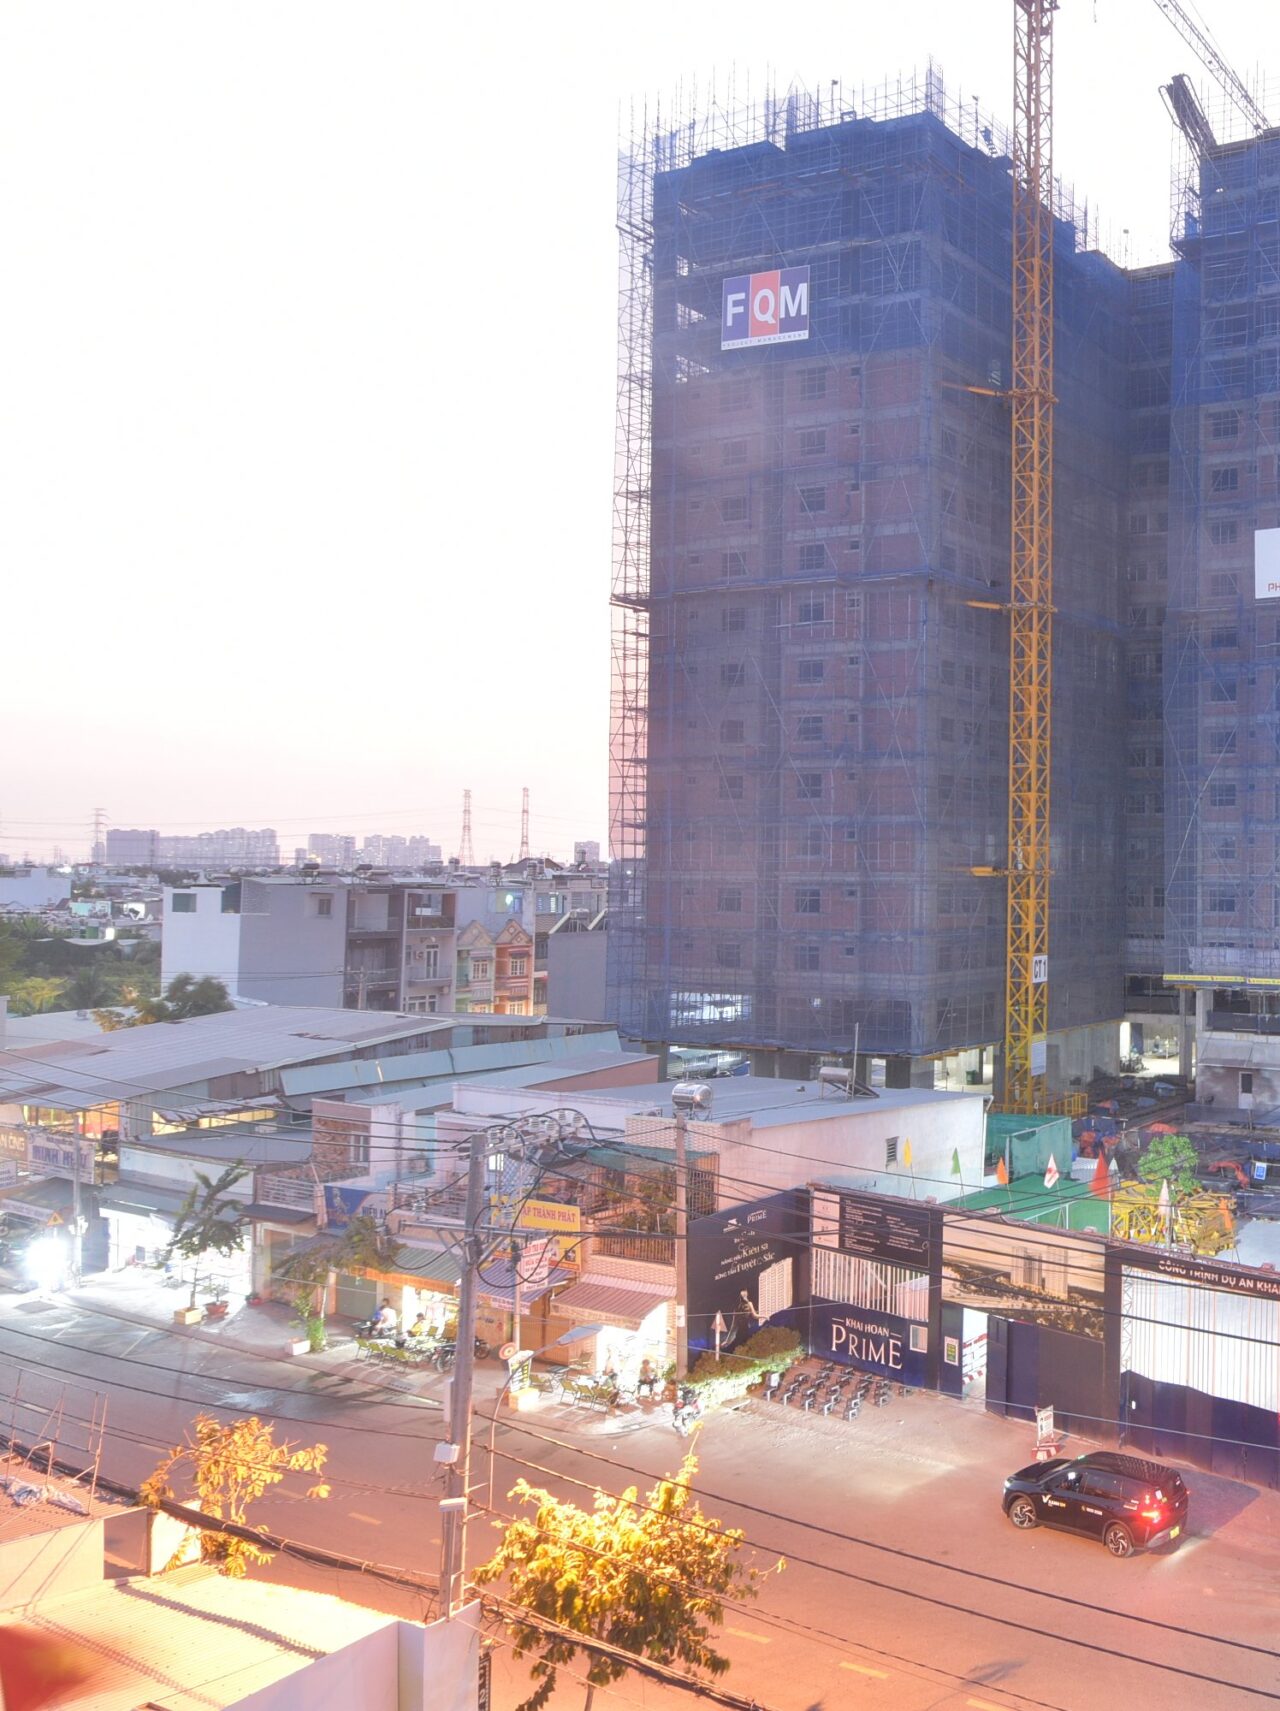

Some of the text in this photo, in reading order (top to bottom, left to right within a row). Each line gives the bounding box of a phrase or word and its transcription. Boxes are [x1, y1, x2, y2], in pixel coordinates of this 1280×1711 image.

[726, 282, 808, 327] FQM
[756, 331, 808, 343] MANAGEMENT
[747, 1210, 767, 1224] PRIME
[845, 1317, 890, 1338] KHAI HOAN
[831, 1324, 903, 1370] PRIME
